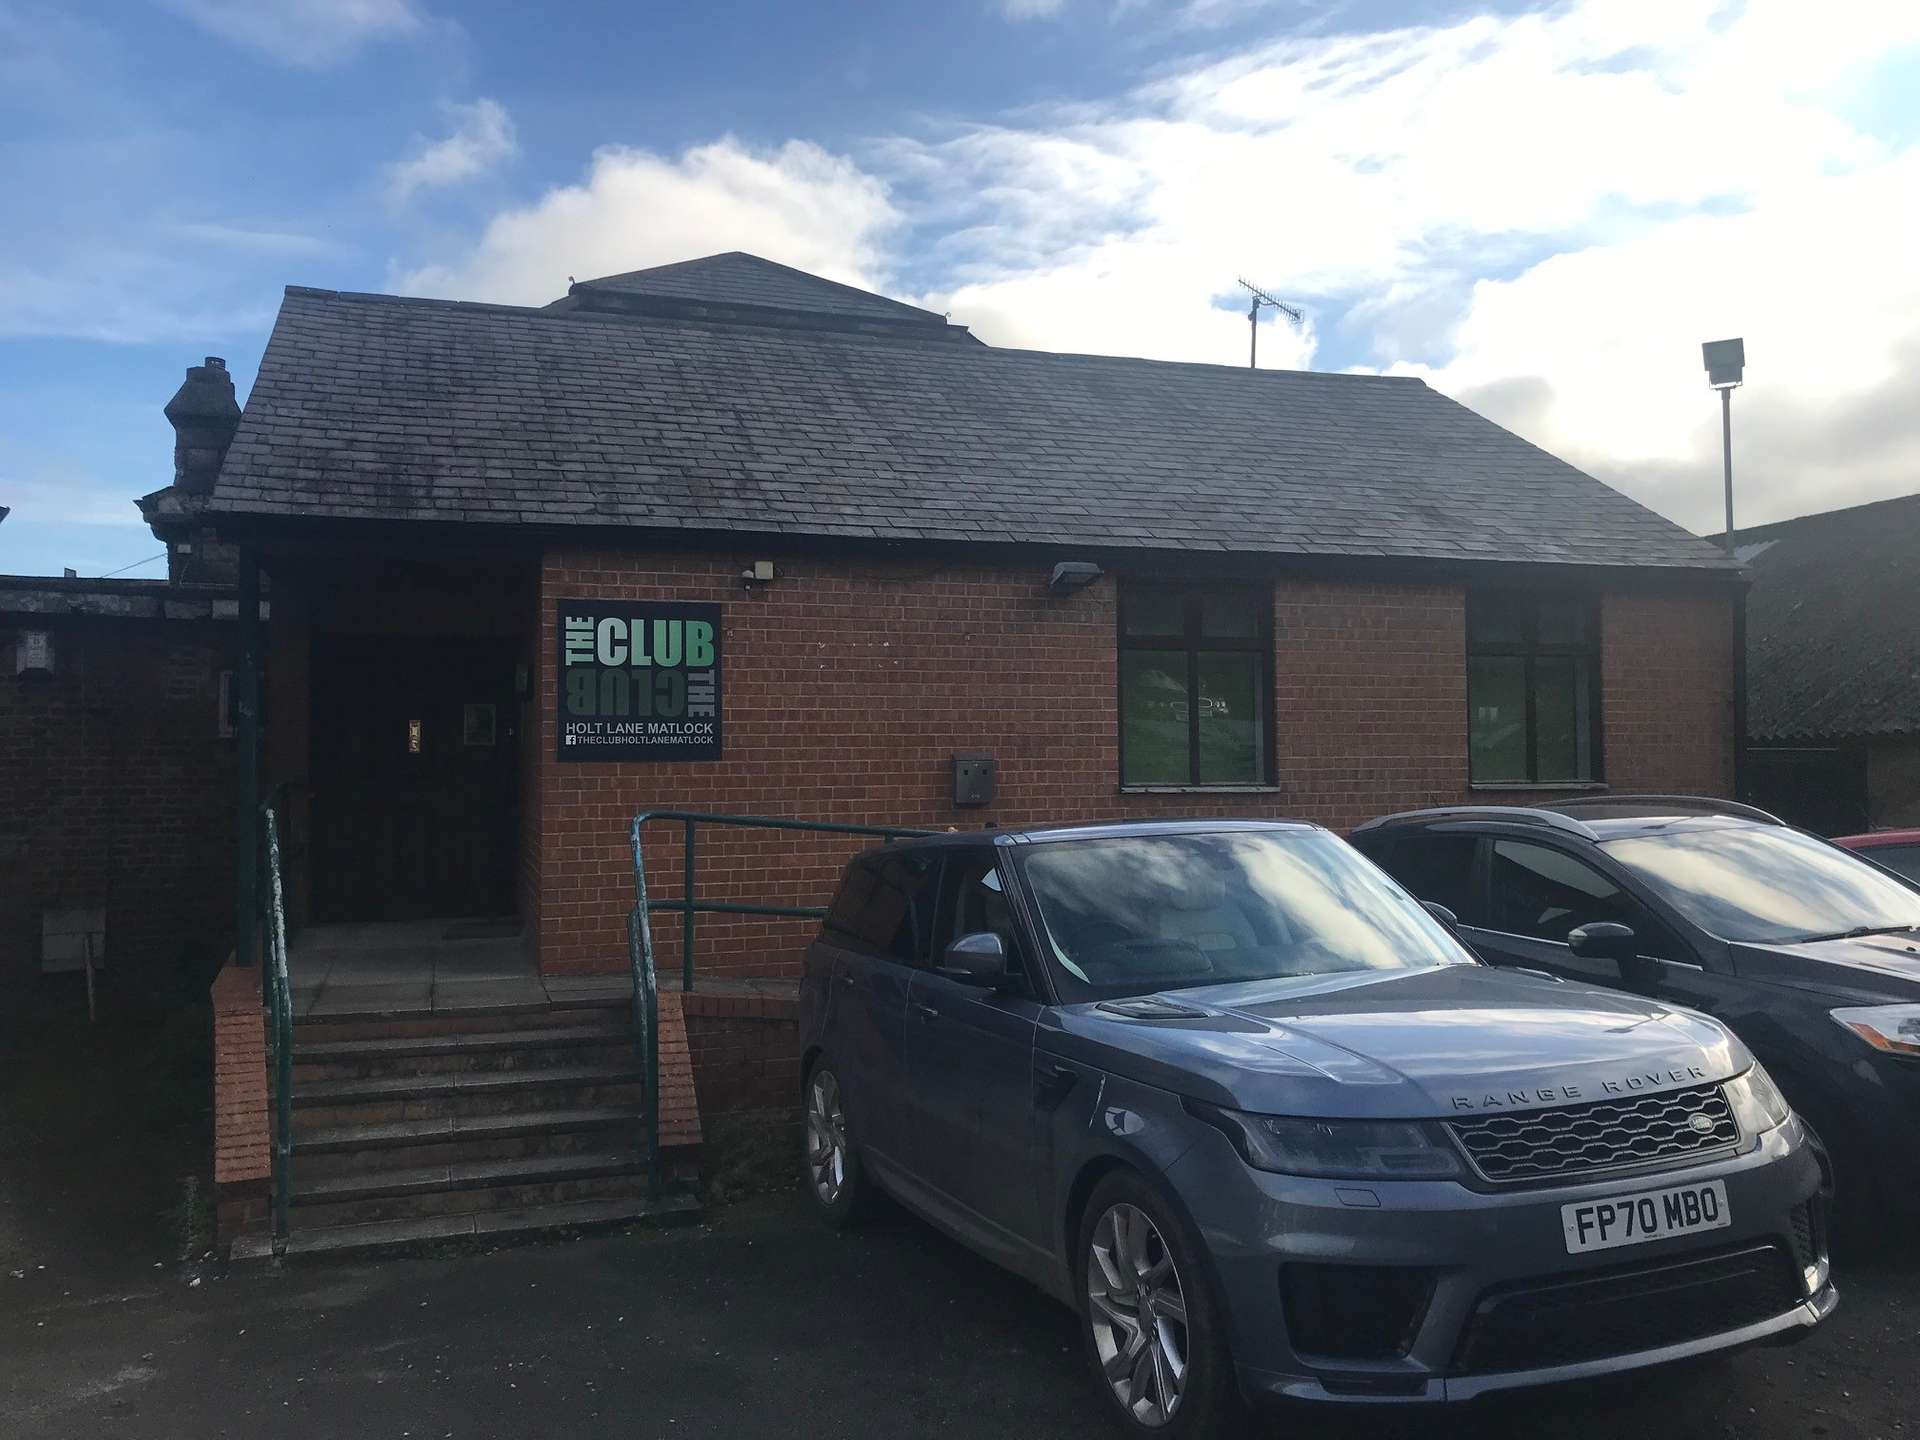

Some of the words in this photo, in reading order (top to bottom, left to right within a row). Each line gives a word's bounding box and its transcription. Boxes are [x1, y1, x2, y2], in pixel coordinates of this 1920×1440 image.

[566, 617, 594, 665] THE
[597, 618, 715, 667] CLUB
[688, 670, 715, 717] THE
[566, 723, 603, 734] HOLT
[607, 723, 644, 734] LANE
[648, 723, 713, 734] MATLOCK
[578, 736, 713, 745] THECLUBHOLTLANEMATLOCK
[1452, 1085, 1582, 1110] RANGE
[1602, 1066, 1706, 1093] ROVER
[1575, 1197, 1658, 1245] FP70
[1662, 1186, 1719, 1230] MBO
